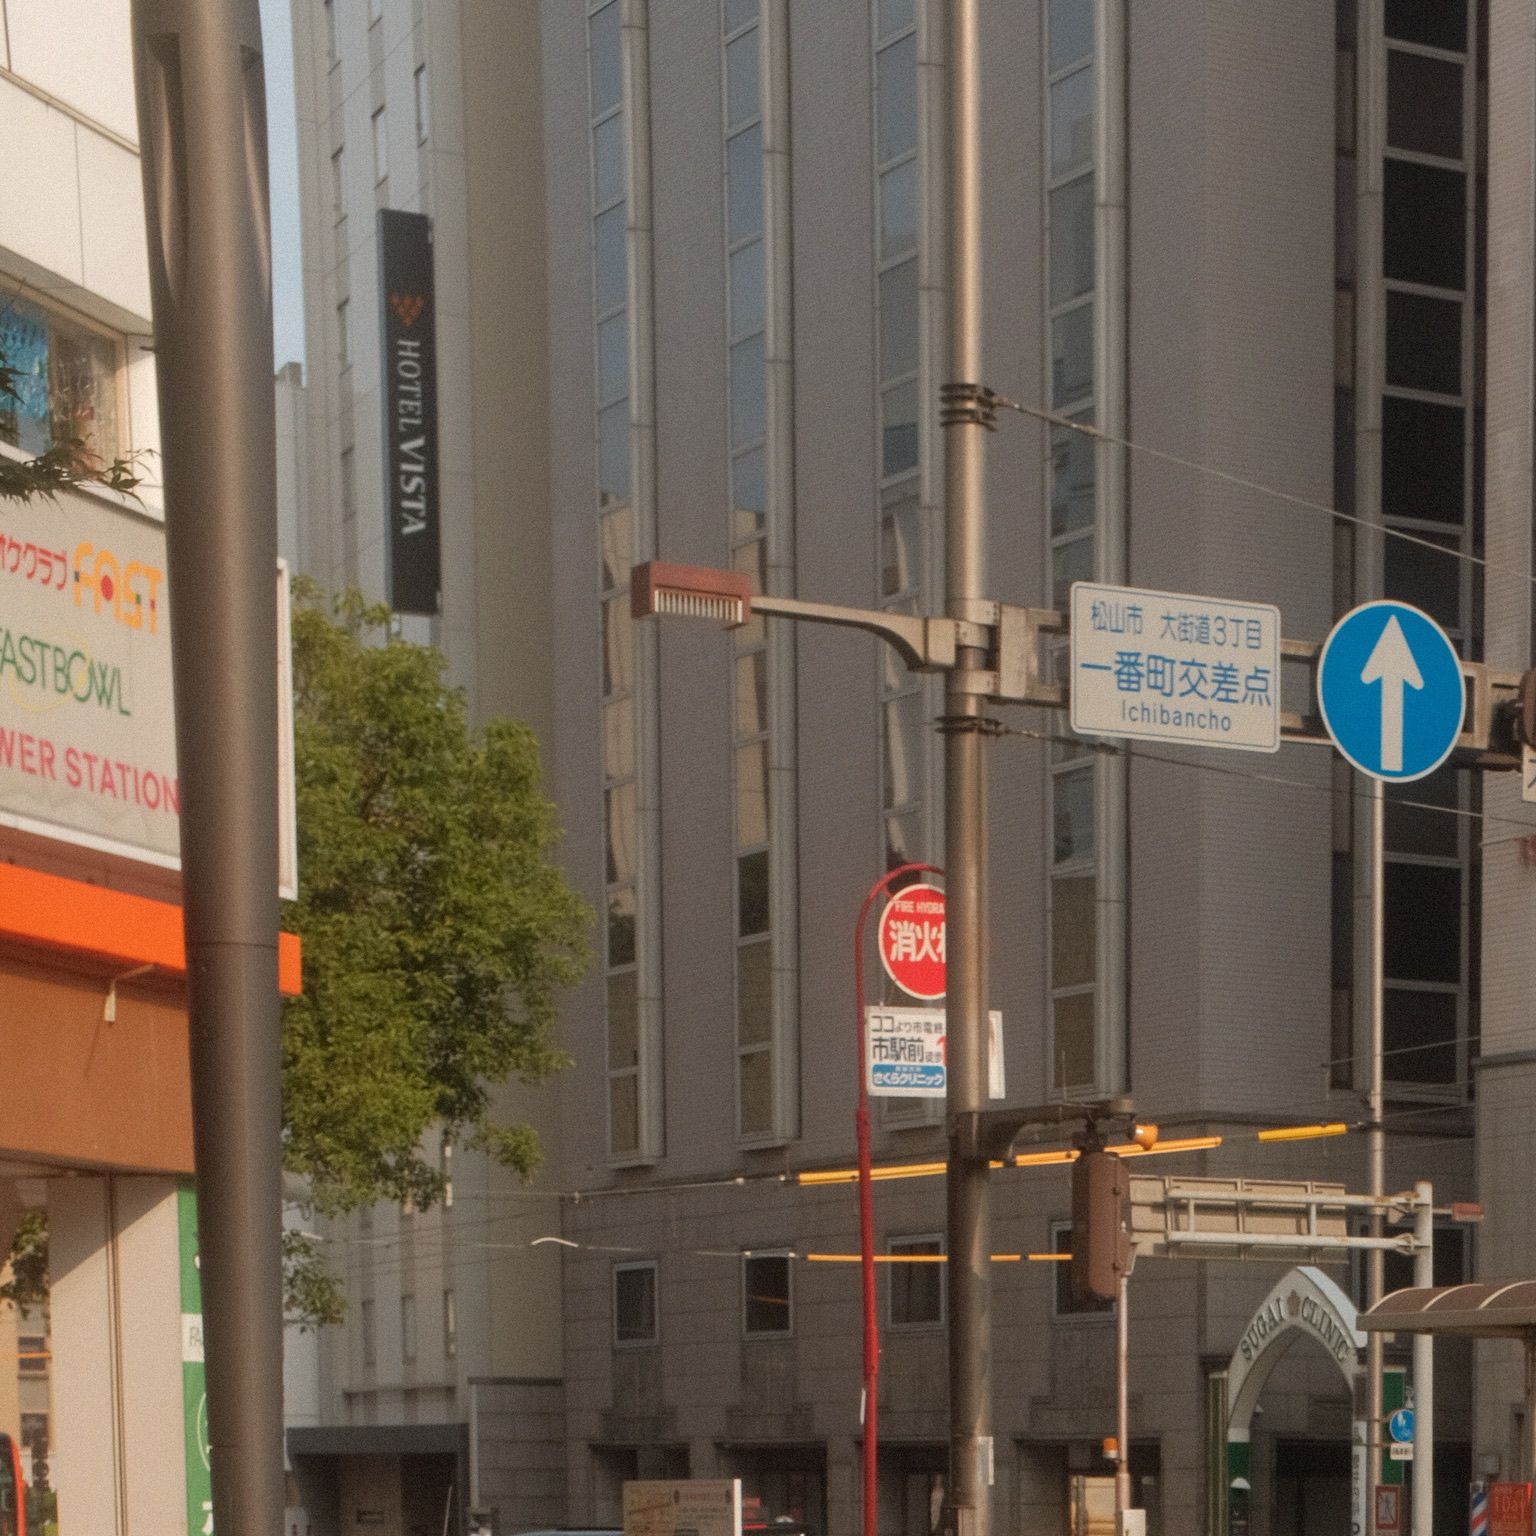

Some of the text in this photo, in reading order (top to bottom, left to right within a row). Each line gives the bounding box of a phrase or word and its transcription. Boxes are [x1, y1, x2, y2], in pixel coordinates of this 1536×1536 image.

[397, 339, 427, 535] HOTEL VISTA
[73, 540, 163, 635] FAST
[1090, 600, 1262, 650] 松山市 大街道3丁目
[0, 626, 131, 717] ASTBOWL
[1079, 650, 1272, 706] 一番町交差点
[1121, 699, 1232, 732] Ichibancho
[895, 901, 915, 913] FIRE
[873, 1071, 944, 1086] さくらクリニック
[1239, 1296, 1350, 1362] SUGAI CLINIC
